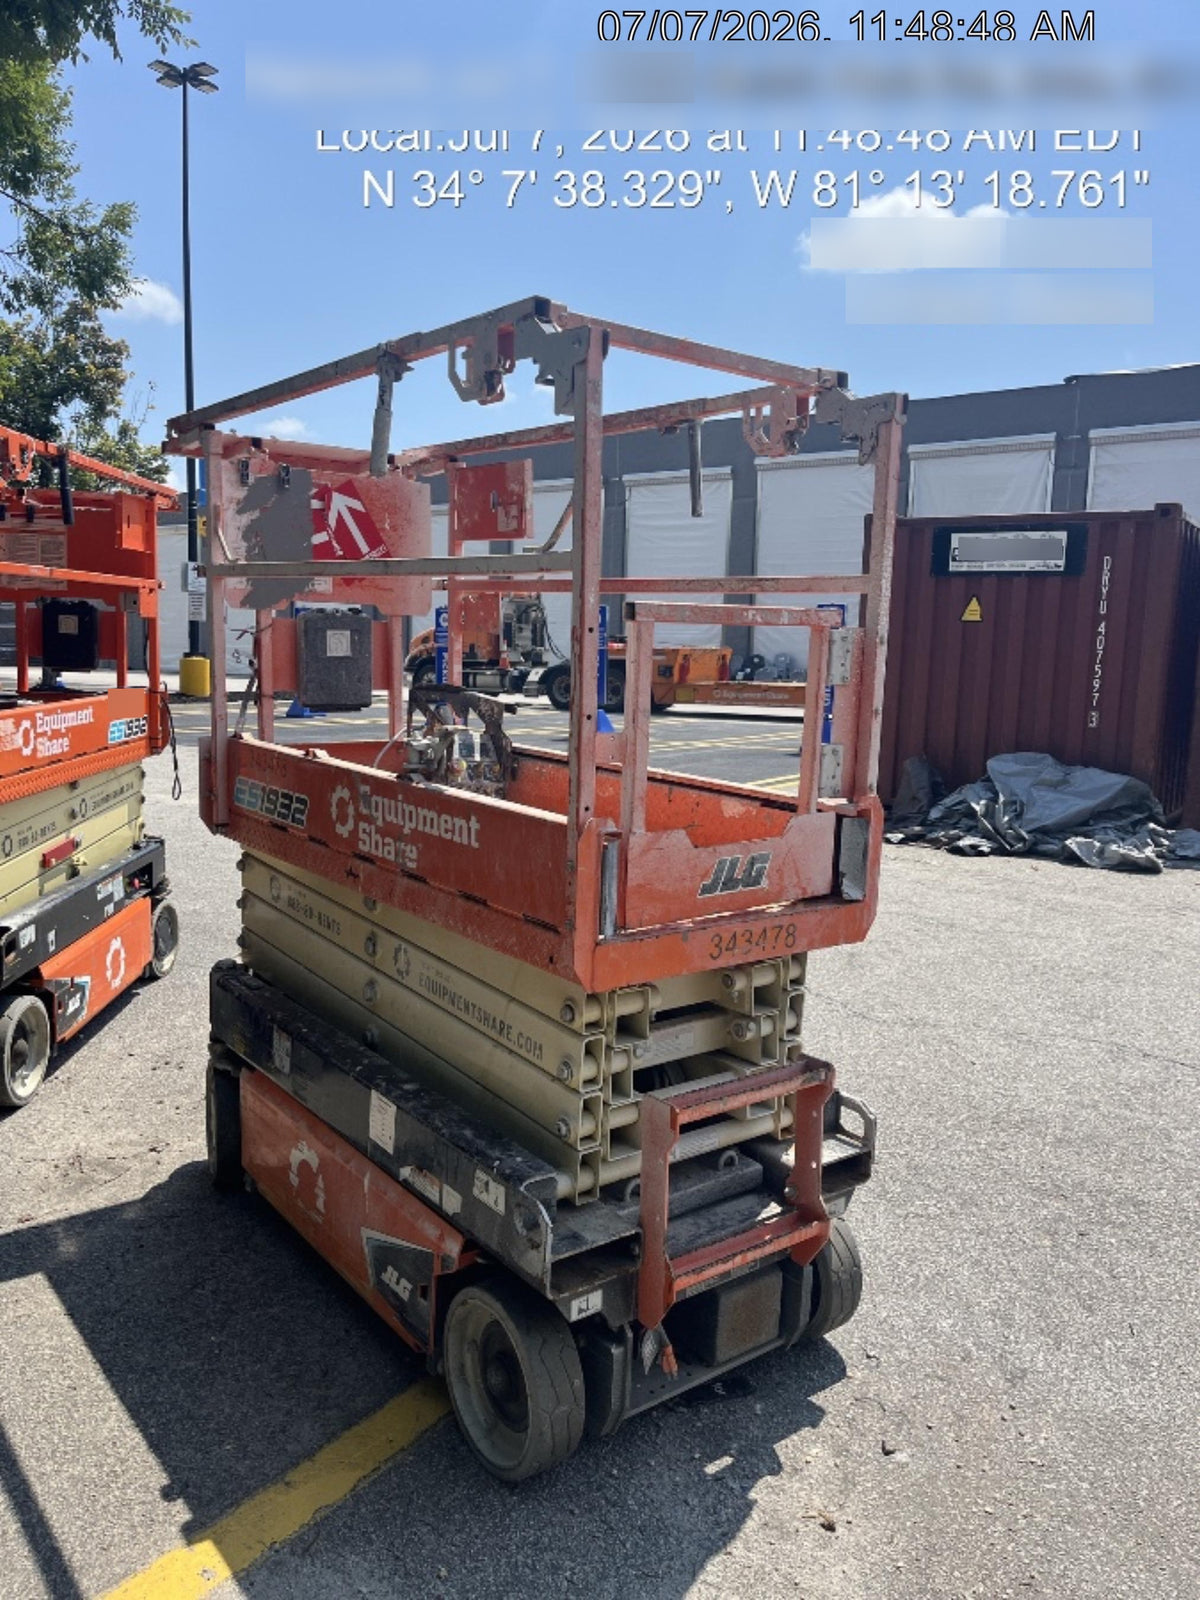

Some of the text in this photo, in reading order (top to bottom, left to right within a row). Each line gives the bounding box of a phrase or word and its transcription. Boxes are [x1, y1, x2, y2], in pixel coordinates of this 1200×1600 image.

[1092, 621, 1106, 706] 407597
[35, 706, 94, 736] Equipment
[36, 735, 70, 759] Share
[234, 775, 310, 829] ES1932
[358, 784, 481, 848] Equipment
[358, 820, 418, 869] Share
[697, 850, 773, 898] JLG
[708, 922, 797, 961] 343478
[418, 974, 544, 1061] EQUIPMENTSHARE.COM
[380, 1264, 413, 1302] JLG
